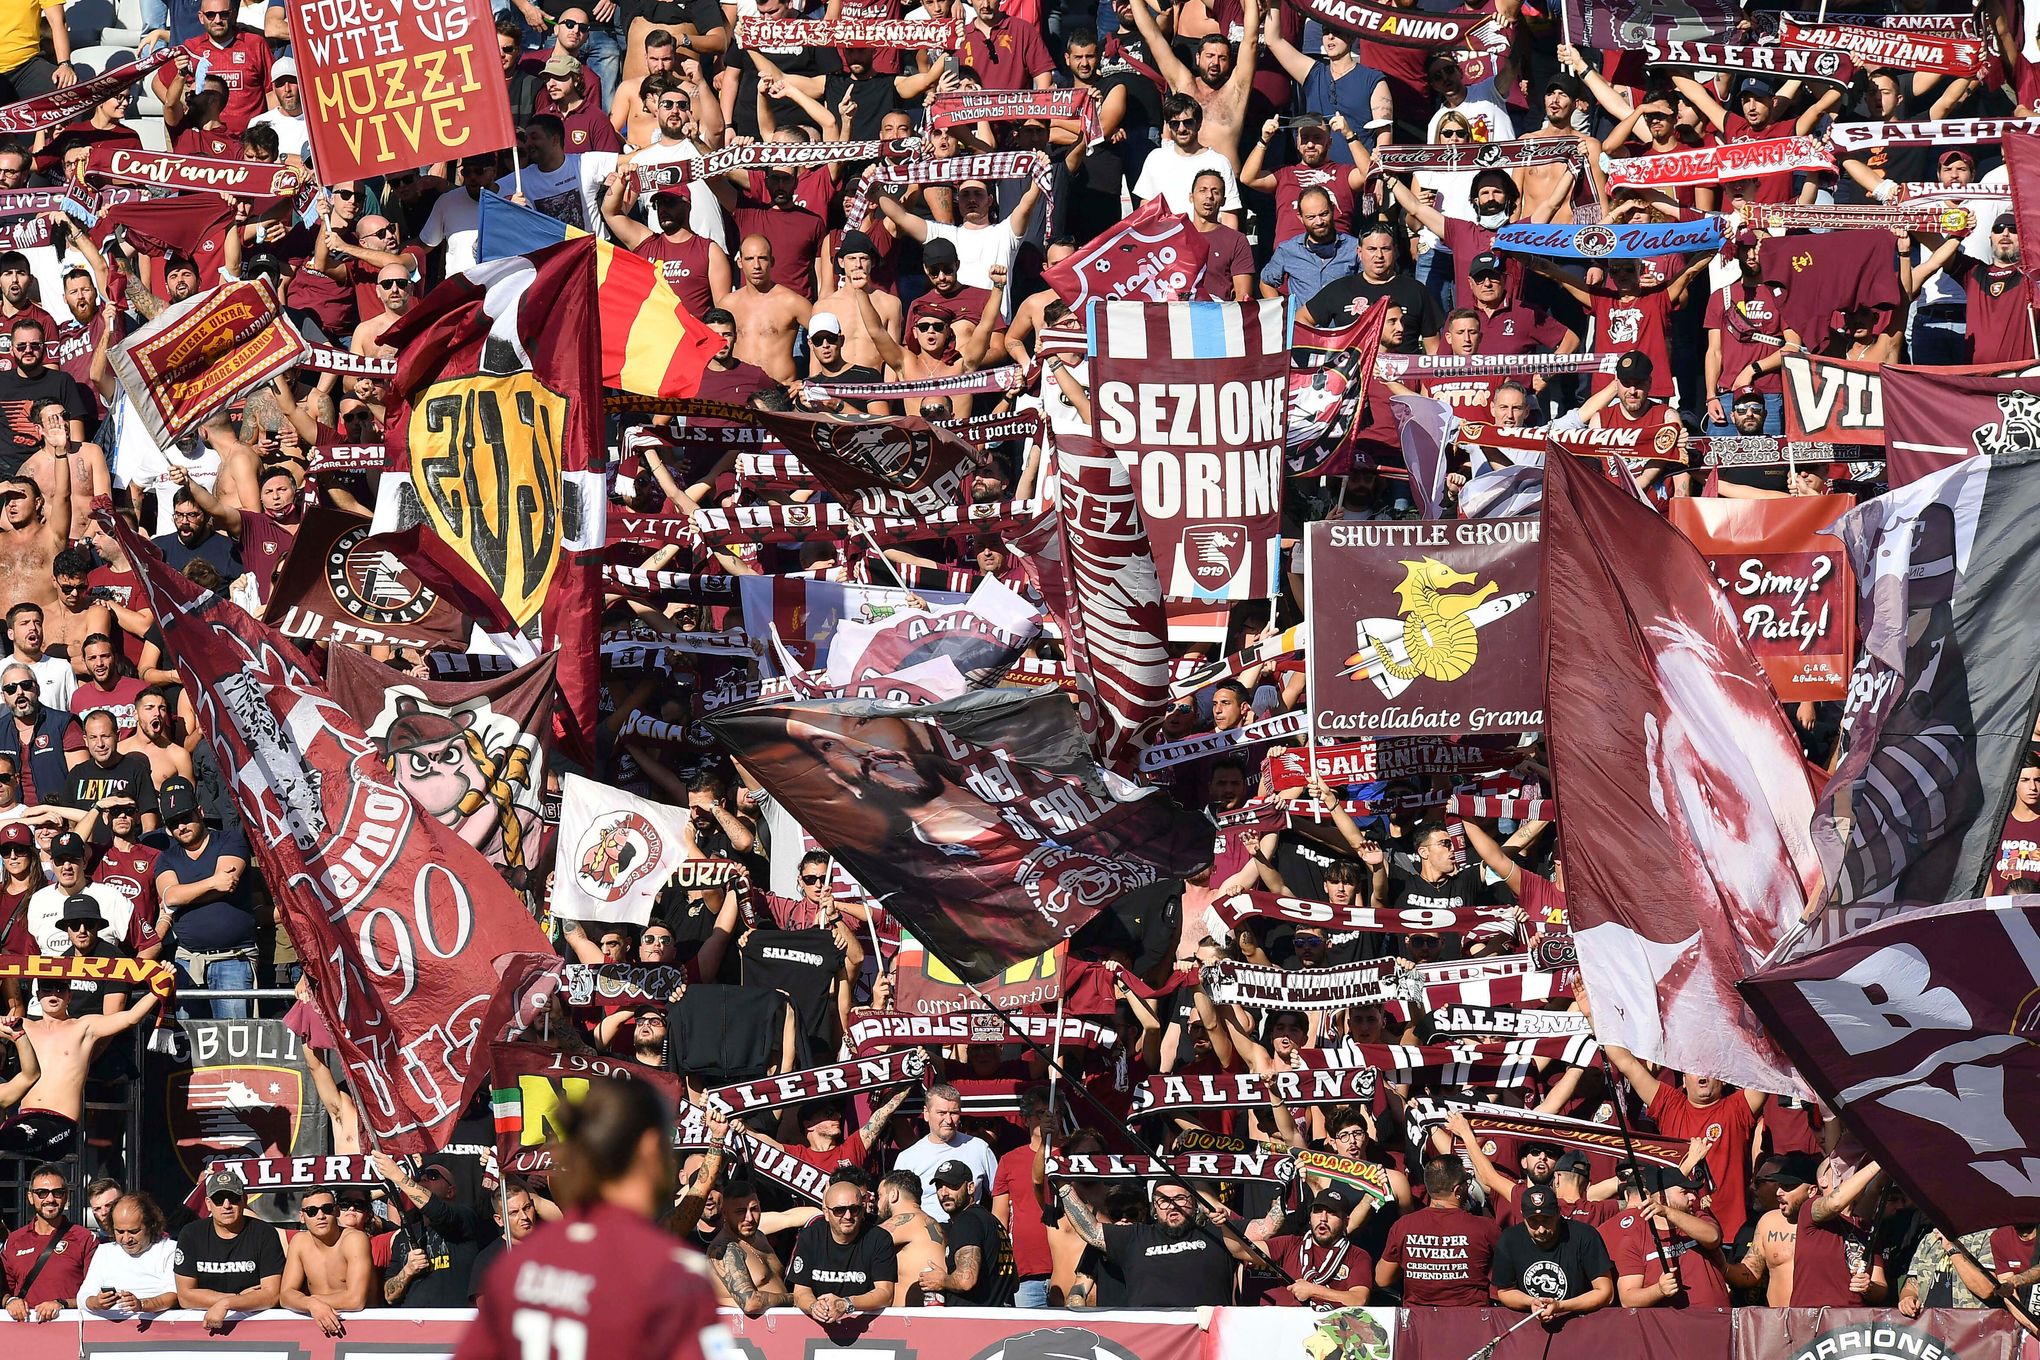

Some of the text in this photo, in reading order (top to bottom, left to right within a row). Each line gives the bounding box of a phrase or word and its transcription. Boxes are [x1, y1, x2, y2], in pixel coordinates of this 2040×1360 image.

[308, 5, 470, 68] WITH US
[750, 22, 947, 42] FORZA SALERNITANA
[1310, 0, 1459, 41] MACTE ANIMO
[1795, 27, 1945, 64] SALERNITANA
[314, 44, 482, 123] MOZZI
[1052, 90, 1074, 104] MA
[338, 97, 471, 167] VIVE
[111, 150, 249, 185] Cent'anni
[708, 145, 861, 172] SOLO SALERNO
[1650, 138, 1786, 180] FORZA BARI
[1619, 226, 1713, 251] Valori
[171, 328, 208, 366] VIVERE
[200, 362, 233, 390] AMARE
[231, 333, 272, 368] SALERNO
[1418, 353, 1465, 369] Club
[1433, 361, 1579, 379] QUELLI DI TORINO
[1099, 376, 1286, 446] SEZIONE
[670, 425, 780, 444] U.S. SAL
[1112, 445, 1281, 519] TORINO
[1329, 523, 1449, 548] SHUTTLE
[1195, 564, 1225, 578] 1919
[1734, 554, 1833, 607] Simy?
[1742, 597, 1830, 652] Party!
[1316, 706, 1545, 732] Castellabate Grana
[1316, 745, 1486, 777] SALERNITANA
[322, 789, 407, 899] erno
[2001, 839, 2038, 852] NORD
[1222, 894, 1458, 931] 1919
[548, 1050, 632, 1083] 1990
[1406, 1234, 1470, 1247] NATI PER
[1406, 1246, 1469, 1260] VIVERLA
[195, 1259, 257, 1275] SALERNO
[1405, 1271, 1470, 1281] DIFENDERLA
[1406, 1261, 1469, 1272] CRESCIUTI PER
